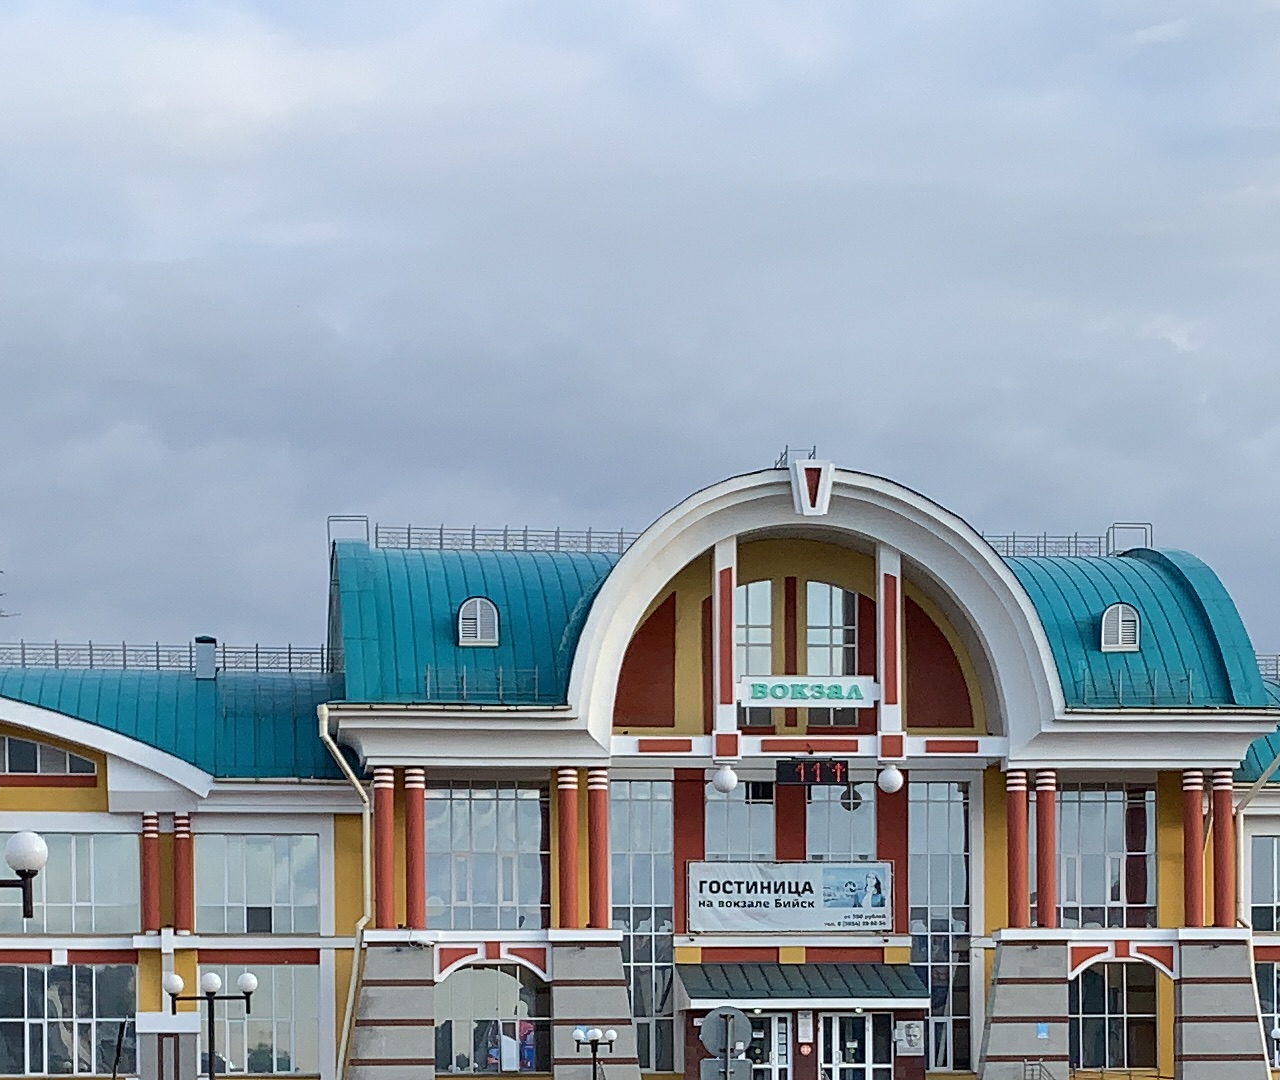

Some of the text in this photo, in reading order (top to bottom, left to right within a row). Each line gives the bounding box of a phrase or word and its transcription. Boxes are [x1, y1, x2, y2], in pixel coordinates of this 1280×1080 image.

[698, 880, 814, 897] ГОСТИНИЦА
[698, 898, 815, 908] на вокзале Бийск
